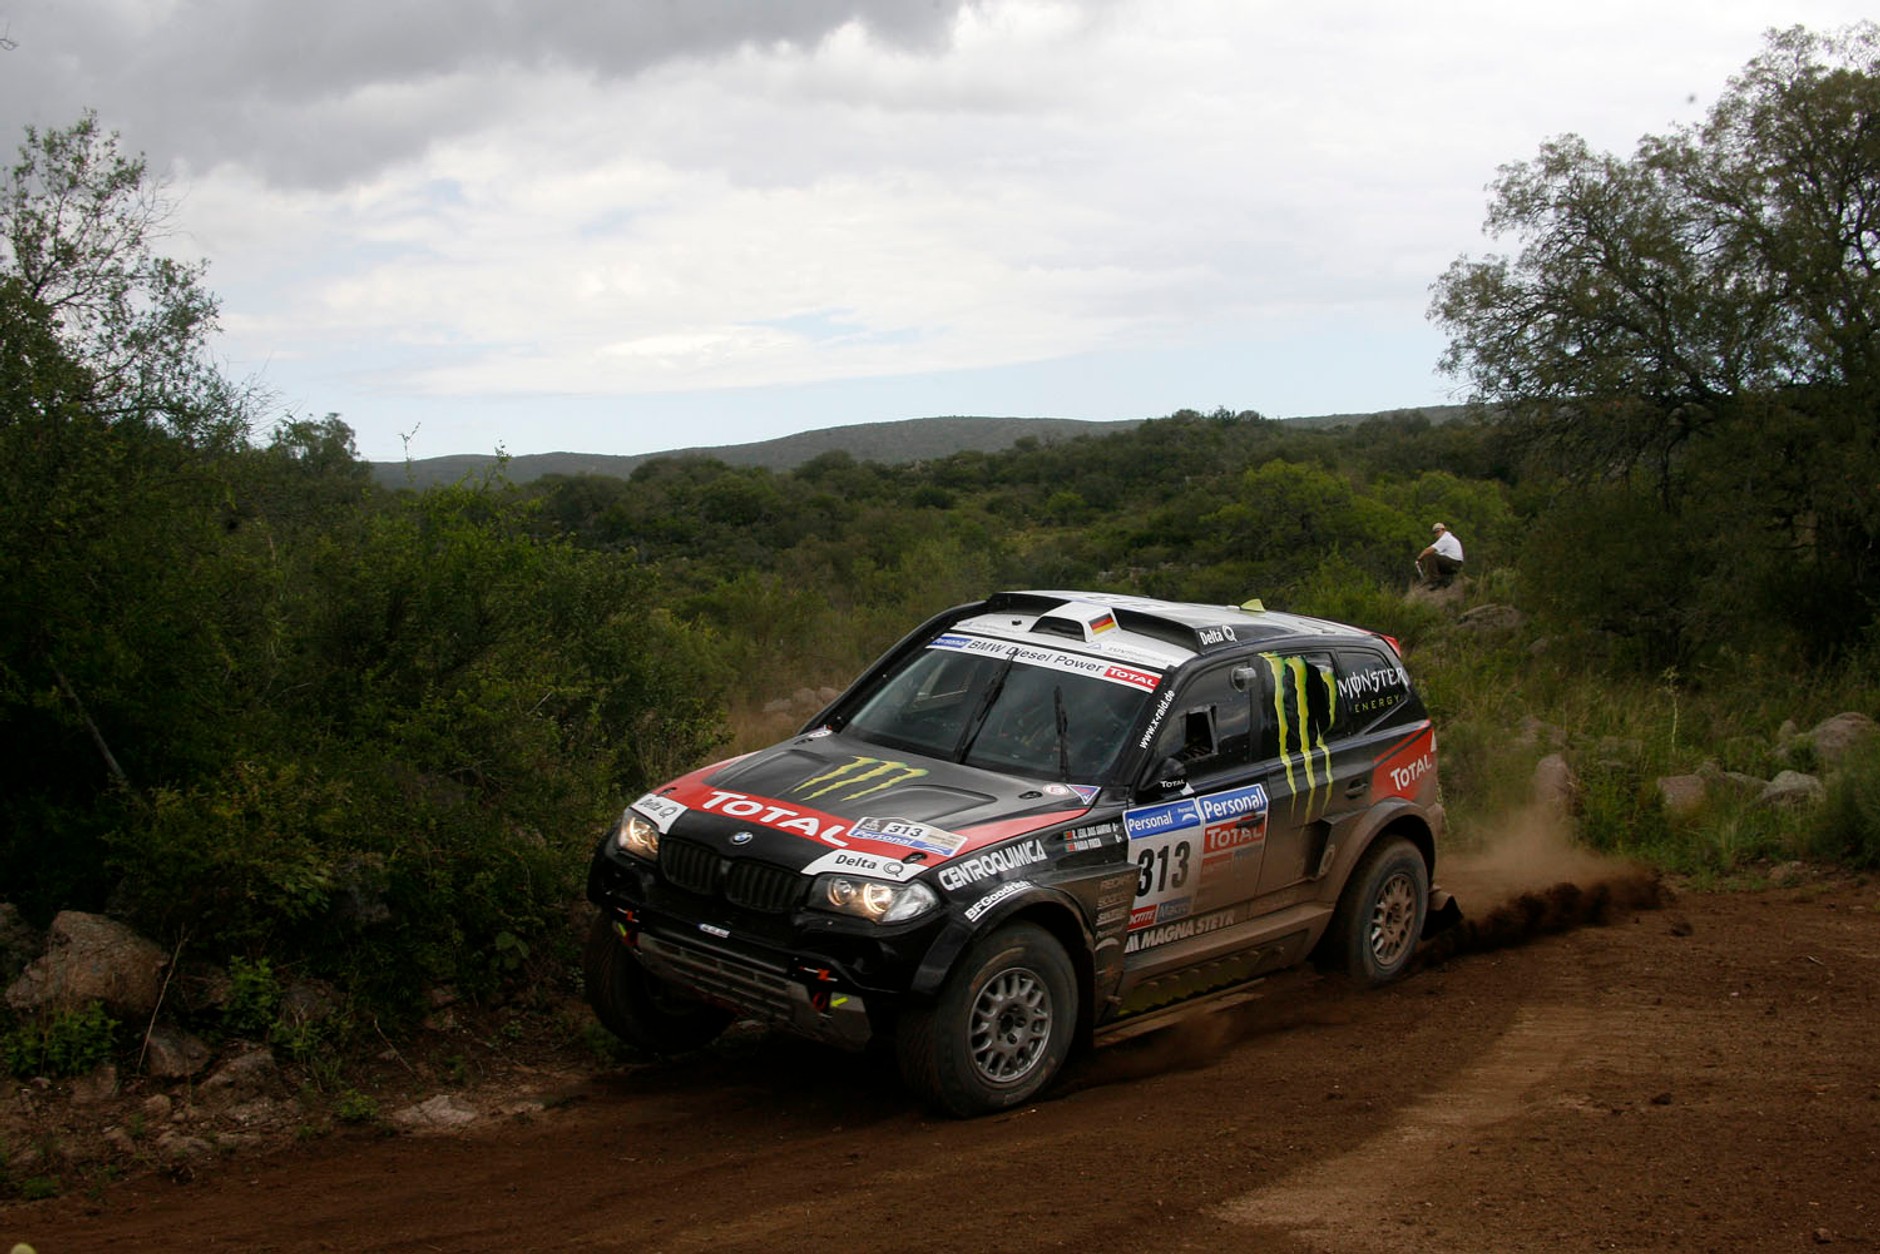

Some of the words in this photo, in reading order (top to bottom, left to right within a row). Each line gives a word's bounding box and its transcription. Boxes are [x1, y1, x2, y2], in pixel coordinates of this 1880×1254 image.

[1199, 629, 1224, 645] Delta
[1222, 624, 1238, 642] Q
[967, 640, 1006, 653] BMW
[1006, 646, 1052, 662] Diesel
[1054, 655, 1105, 673] Power
[1109, 667, 1156, 687] TOTAL
[1354, 694, 1400, 713] ENERGY
[1139, 689, 1175, 749] www.x-raid.de
[1161, 779, 1185, 788] TOTAL
[1390, 754, 1432, 791] TOTAL
[1203, 787, 1264, 819] Personal
[702, 791, 848, 847] TOTAL
[888, 825, 923, 837] 313
[1128, 811, 1173, 832] Personal
[1207, 827, 1262, 849] TOTAL
[835, 854, 877, 870] Delta
[883, 861, 904, 877] Q
[938, 839, 1048, 891] CENTROQUIMICA
[1136, 841, 1191, 897] 313
[963, 880, 1033, 920] BFGoodrich
[1140, 920, 1195, 950] MAGNA
